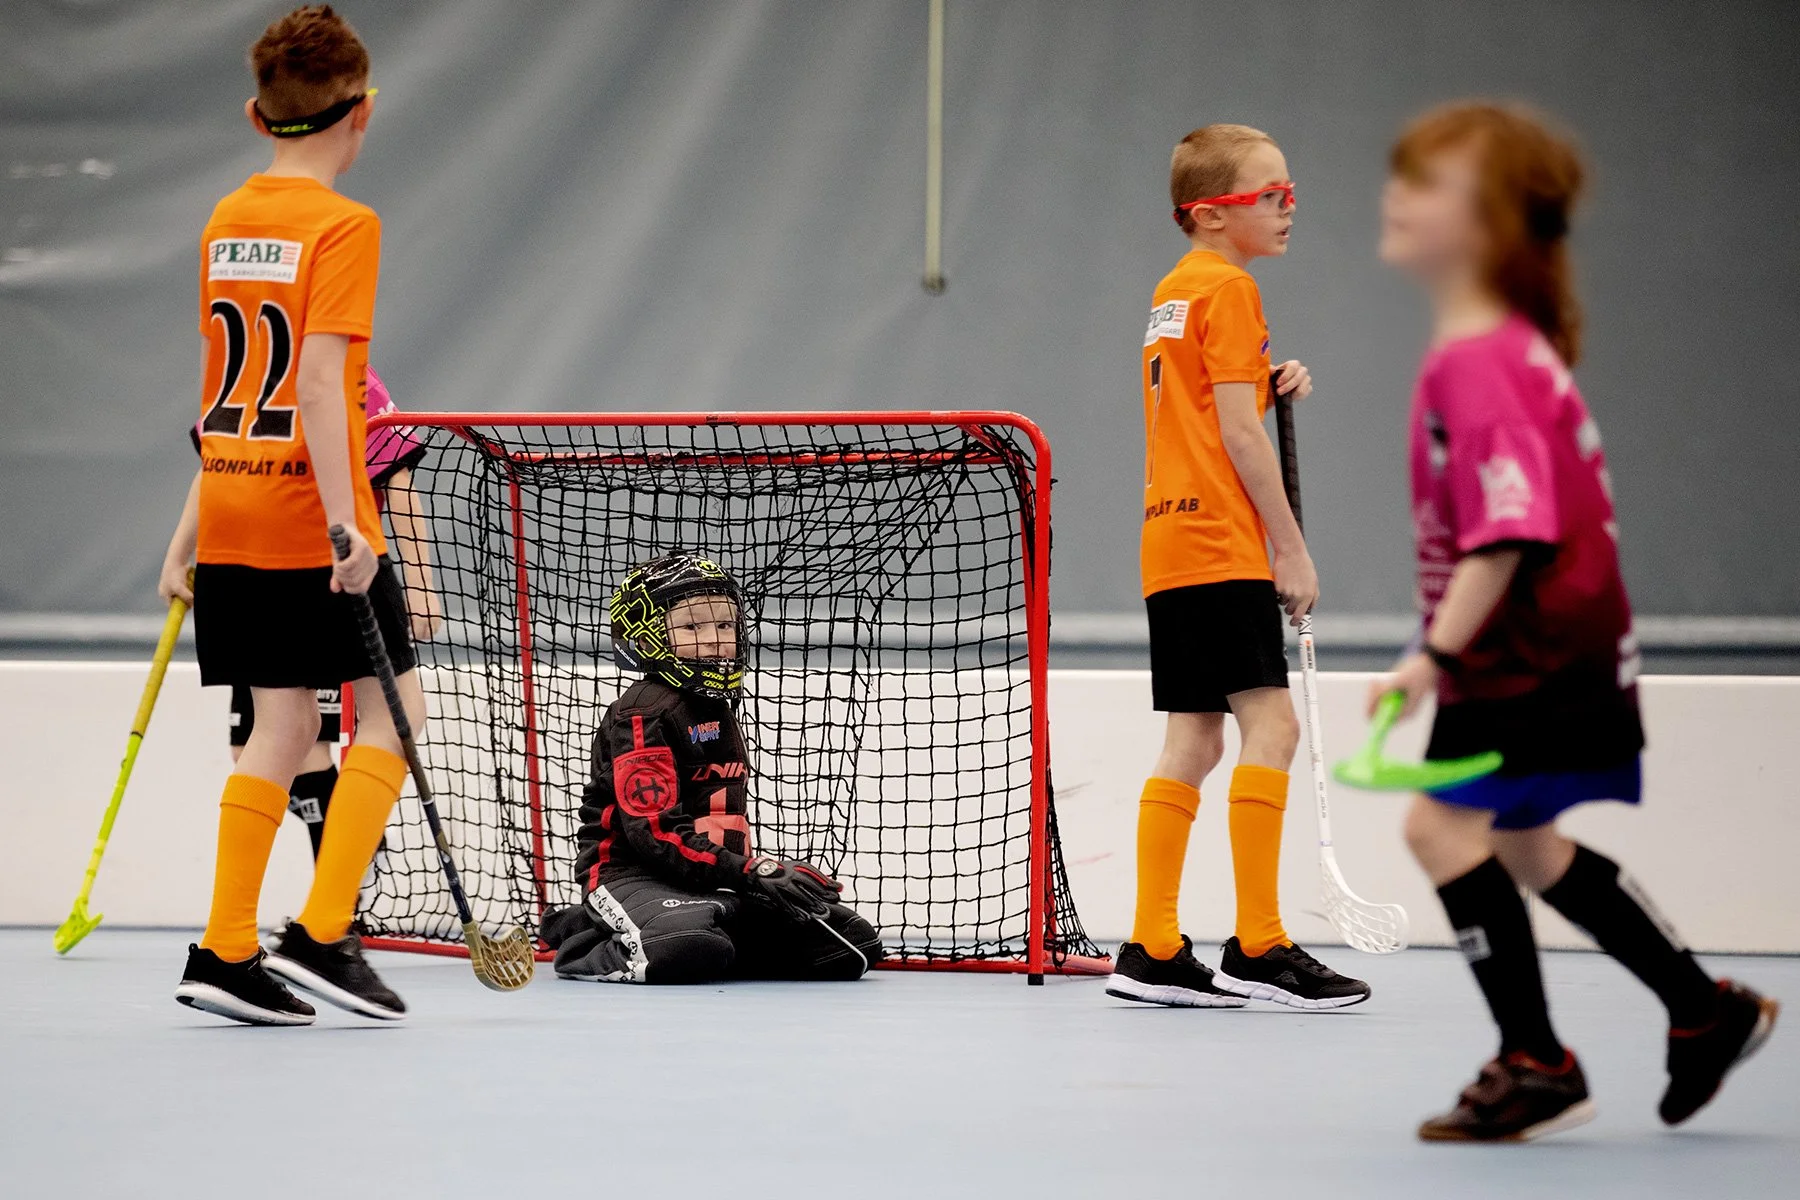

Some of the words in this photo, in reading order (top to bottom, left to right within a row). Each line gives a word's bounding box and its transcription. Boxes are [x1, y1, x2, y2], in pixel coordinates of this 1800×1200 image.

[214, 242, 282, 263] PEAB
[201, 298, 298, 442] 22
[281, 461, 307, 476] AB
[1175, 497, 1200, 513] AB
